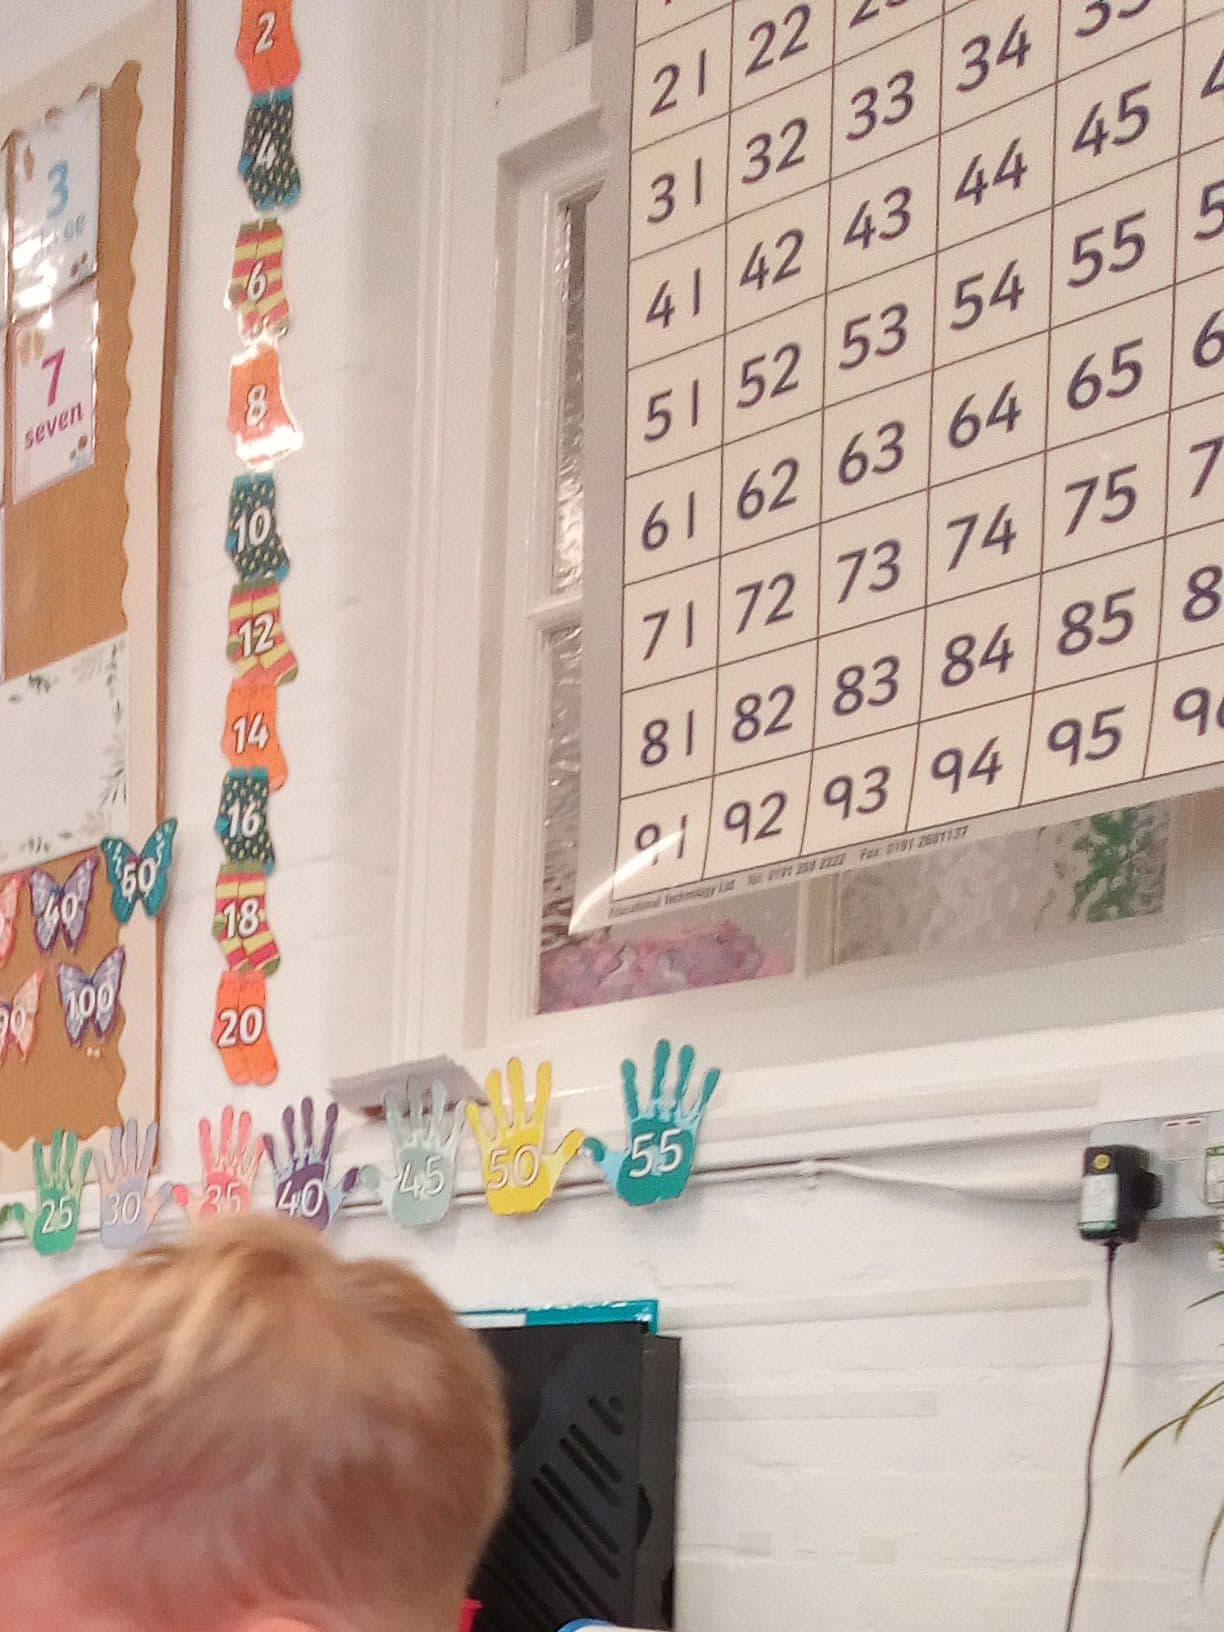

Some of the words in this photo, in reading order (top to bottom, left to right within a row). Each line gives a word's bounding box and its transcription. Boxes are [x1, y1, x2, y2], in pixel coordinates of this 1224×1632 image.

[254, 12, 275, 54] 2
[649, 48, 707, 117] 21
[744, 3, 811, 77] 22
[646, 157, 703, 224] 31
[741, 117, 808, 184] 32
[846, 69, 915, 141] 33
[955, 13, 1032, 93] 34
[256, 134, 277, 171] 4
[47, 160, 68, 220] 3
[645, 267, 701, 329] 41
[739, 229, 804, 291] 42
[843, 185, 912, 251] 43
[954, 137, 1028, 207] 44
[1071, 80, 1151, 158] 45
[246, 262, 267, 300] 6
[644, 379, 699, 443] 51
[736, 342, 801, 410] 52
[838, 302, 909, 370] 53
[949, 259, 1025, 331] 54
[1067, 210, 1146, 289] 55
[1194, 178, 1224, 240] 5
[41, 349, 65, 407] 7
[24, 402, 83, 451] seven
[246, 385, 267, 427] 8
[641, 491, 695, 551] 61
[736, 457, 799, 520] 62
[838, 421, 905, 486] 63
[948, 380, 1022, 449] 64
[1066, 337, 1143, 411] 65
[1192, 310, 1224, 368] 6
[234, 505, 271, 553] 10
[642, 600, 694, 661] 71
[735, 572, 796, 635] 72
[837, 539, 901, 605] 73
[946, 502, 1017, 572] 74
[1064, 463, 1138, 537] 75
[238, 612, 274, 657] 12
[640, 708, 695, 767] 81
[731, 684, 796, 743] 82
[833, 655, 900, 717] 83
[941, 622, 1015, 688] 84
[1057, 587, 1136, 656] 85
[1182, 564, 1224, 623] 8
[232, 712, 270, 755] 14
[634, 814, 688, 866] 91
[724, 791, 787, 845] 92
[823, 765, 891, 820] 93
[931, 735, 1003, 794] 94
[1047, 705, 1126, 767] 95
[225, 801, 261, 840] 16
[44, 893, 78, 928] 40
[222, 898, 260, 939] 18
[67, 982, 115, 1024] 100
[217, 1006, 265, 1048] 20
[40, 1198, 74, 1236] 25
[106, 1191, 141, 1226] 30
[205, 1183, 242, 1213] 35
[277, 1178, 324, 1219] 40
[396, 1157, 445, 1197] 45
[487, 1143, 540, 1191] 50
[629, 1127, 683, 1179] 55
